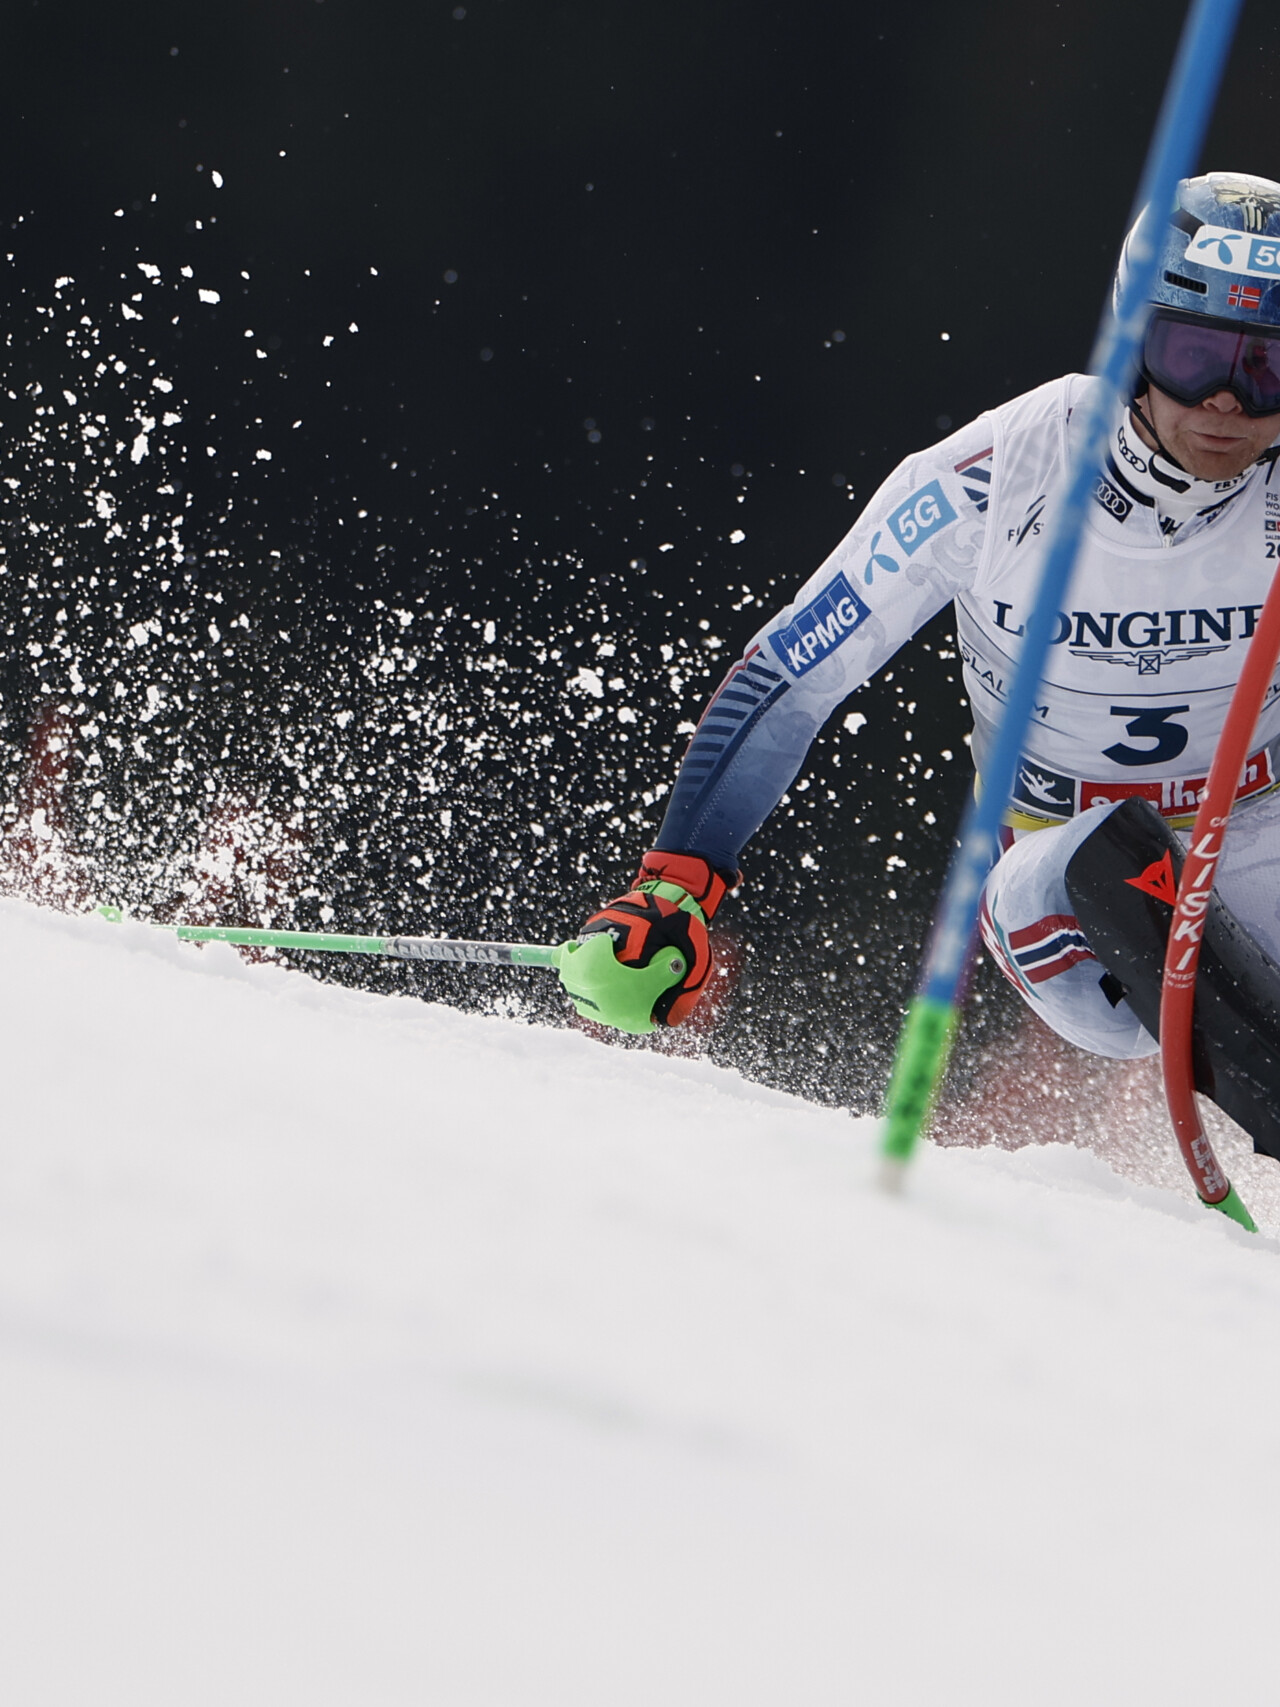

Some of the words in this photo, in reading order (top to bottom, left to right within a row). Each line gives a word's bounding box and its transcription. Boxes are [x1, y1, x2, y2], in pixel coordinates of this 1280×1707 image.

[897, 495, 943, 543] 5G
[1266, 492, 1278, 502] FIS
[787, 596, 860, 673] KPMG
[992, 600, 1264, 648] LONGINE
[961, 645, 1049, 719] SLALM
[1101, 704, 1190, 766] 3
[1174, 833, 1220, 971] LISKI
